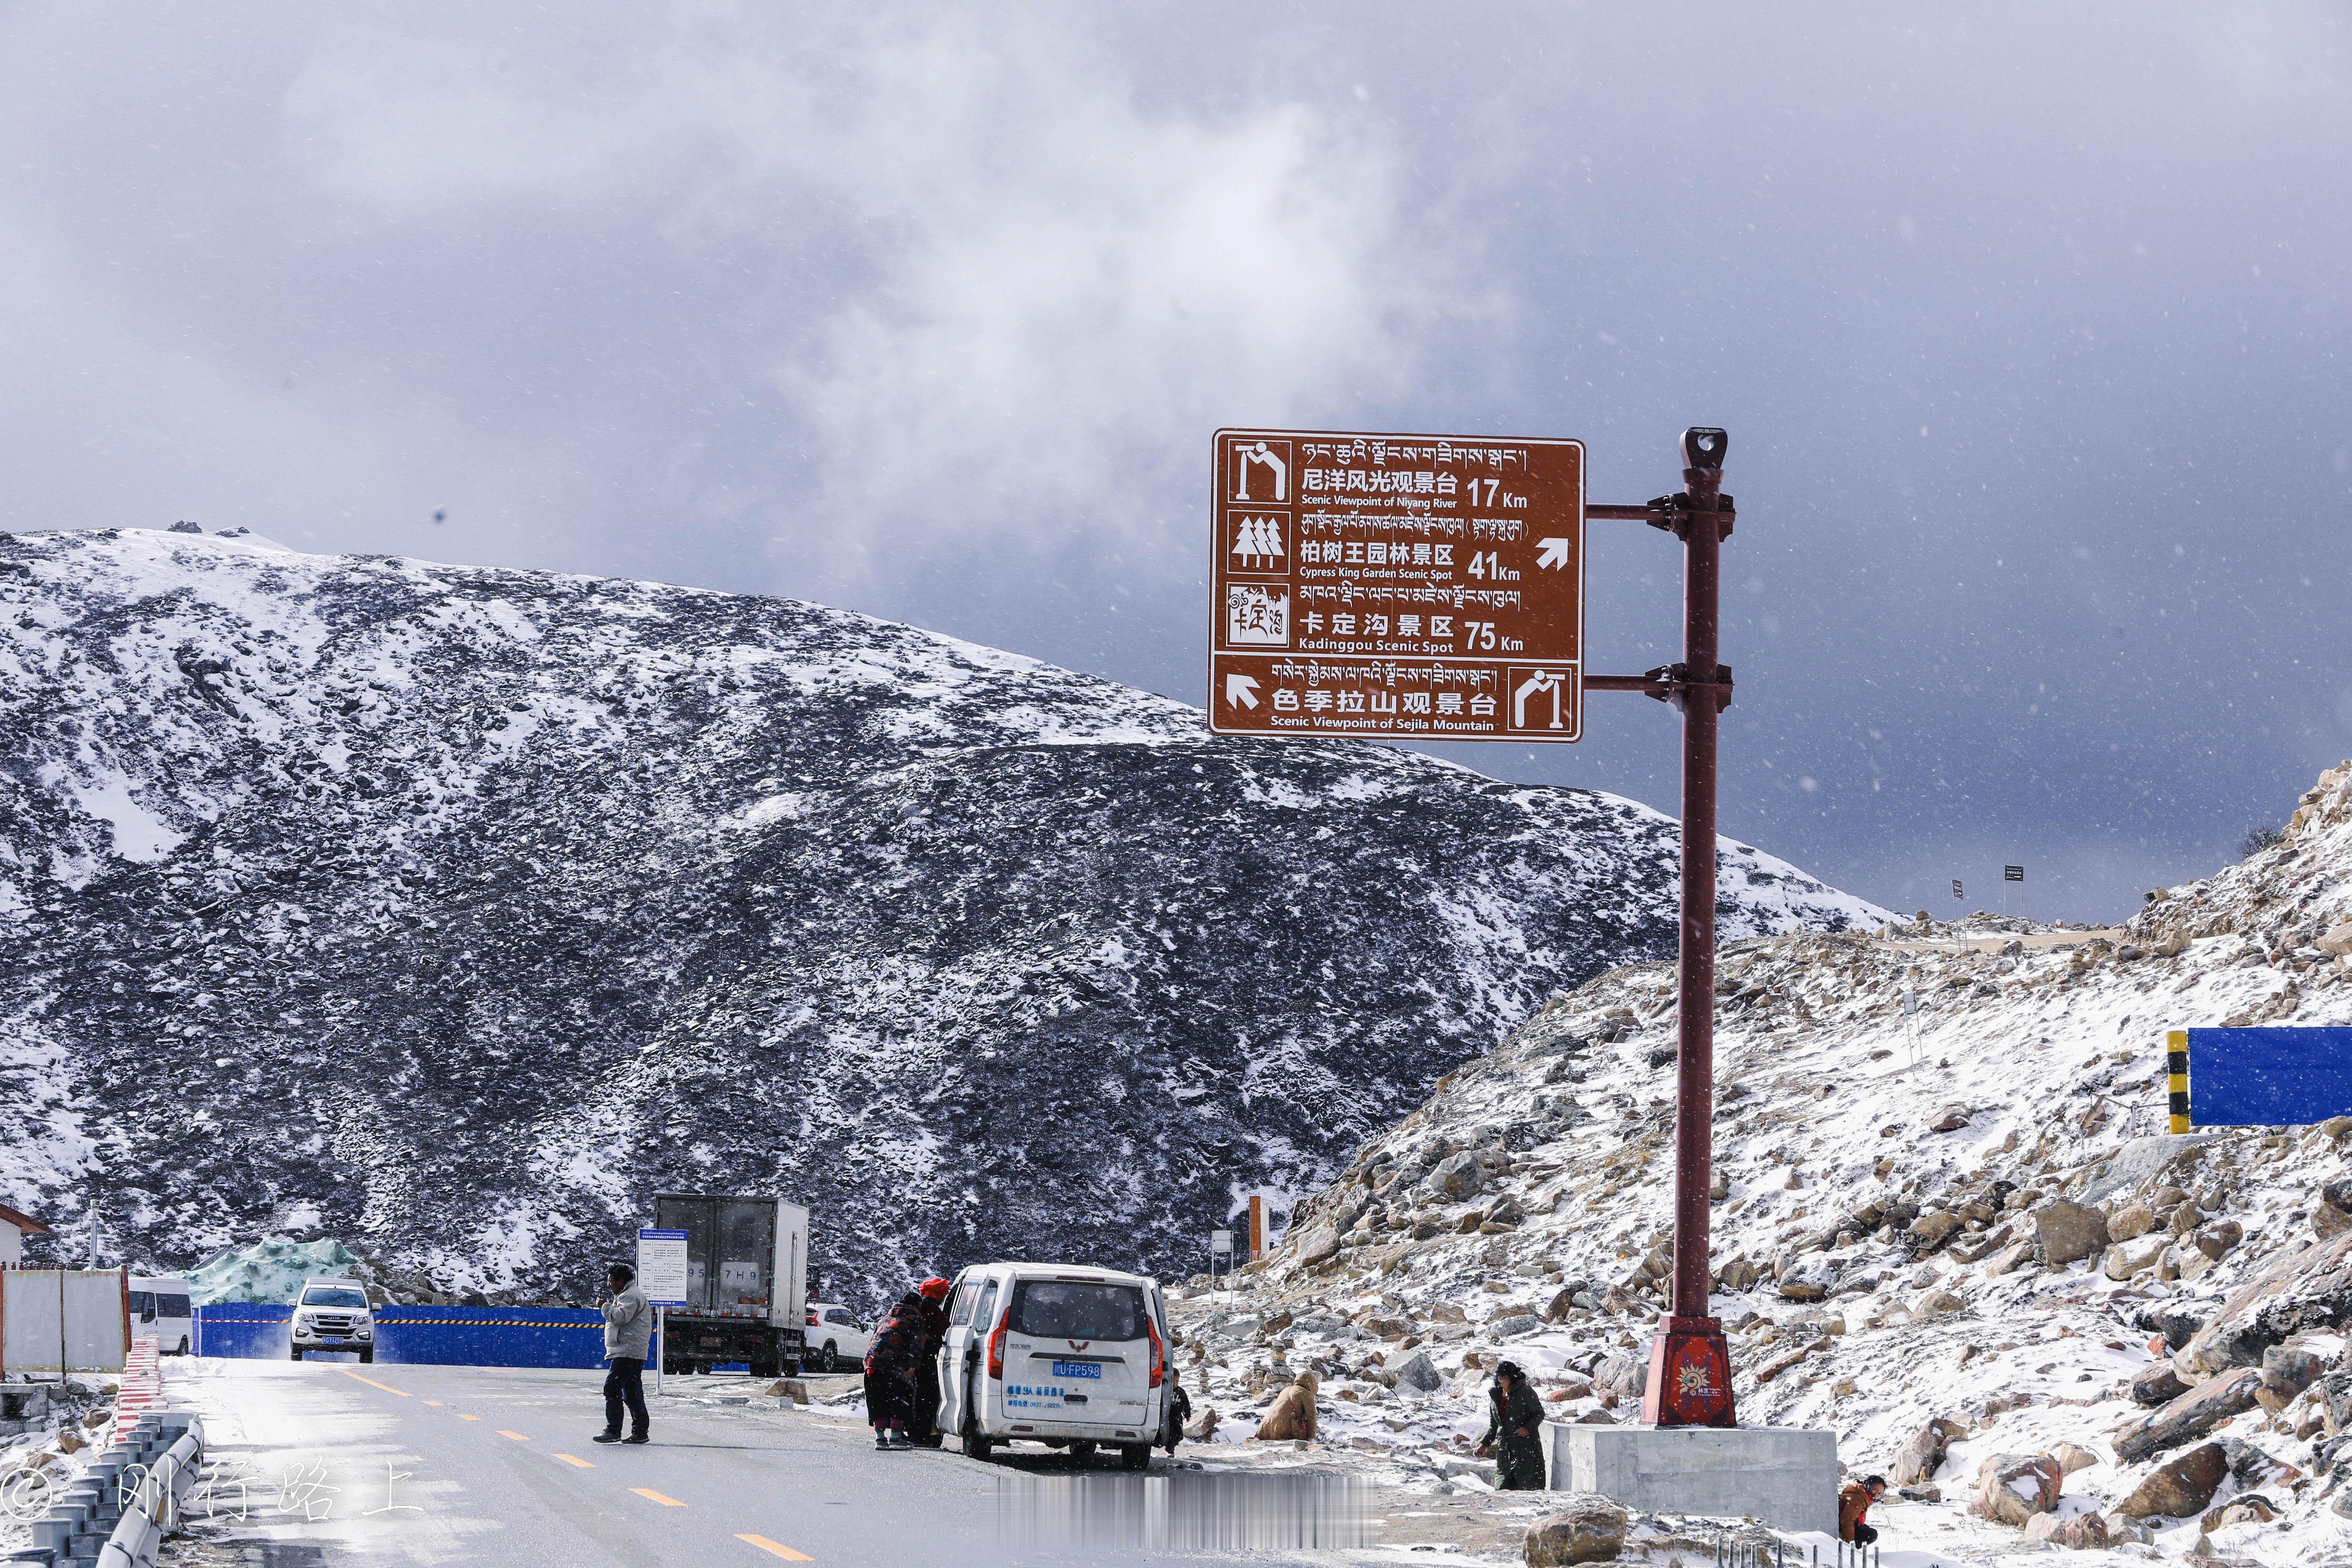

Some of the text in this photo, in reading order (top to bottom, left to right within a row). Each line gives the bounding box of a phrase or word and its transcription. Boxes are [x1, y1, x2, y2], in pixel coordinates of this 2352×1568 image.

[1302, 469, 1527, 507] 尼洋风光观景台 17 Km
[1302, 495, 1457, 509] Scenic Viewpoint of Niyang River
[1301, 540, 1520, 580] 柏树王园林景区 41 Km
[1300, 567, 1452, 582] Cypress King Garden Scenic Spot
[1300, 611, 1523, 650] 卡定沟景区 75 Km
[1300, 638, 1453, 655] Kadinggou Scenic Spot
[1271, 688, 1497, 716] 色季拉山观景台
[1271, 716, 1493, 731] Scenic Viewpoint of Sejila Mountain
